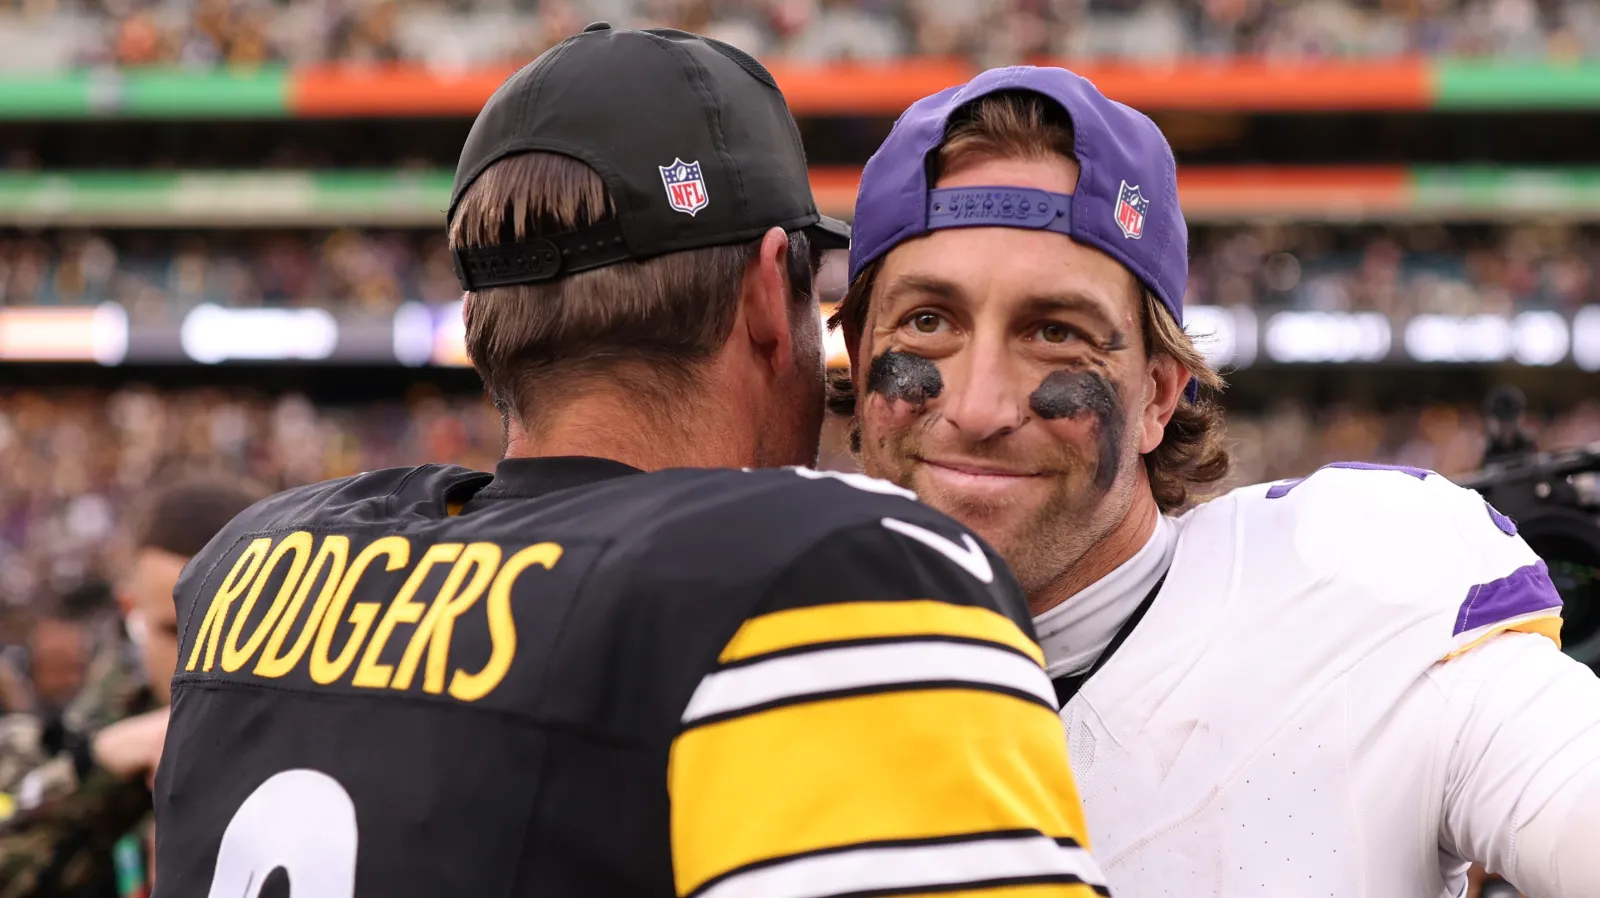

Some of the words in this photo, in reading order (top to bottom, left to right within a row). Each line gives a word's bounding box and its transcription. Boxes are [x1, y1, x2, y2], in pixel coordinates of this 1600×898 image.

[671, 182, 705, 208] NFL
[1120, 201, 1141, 234] NFL
[186, 531, 563, 701] RODGERS
